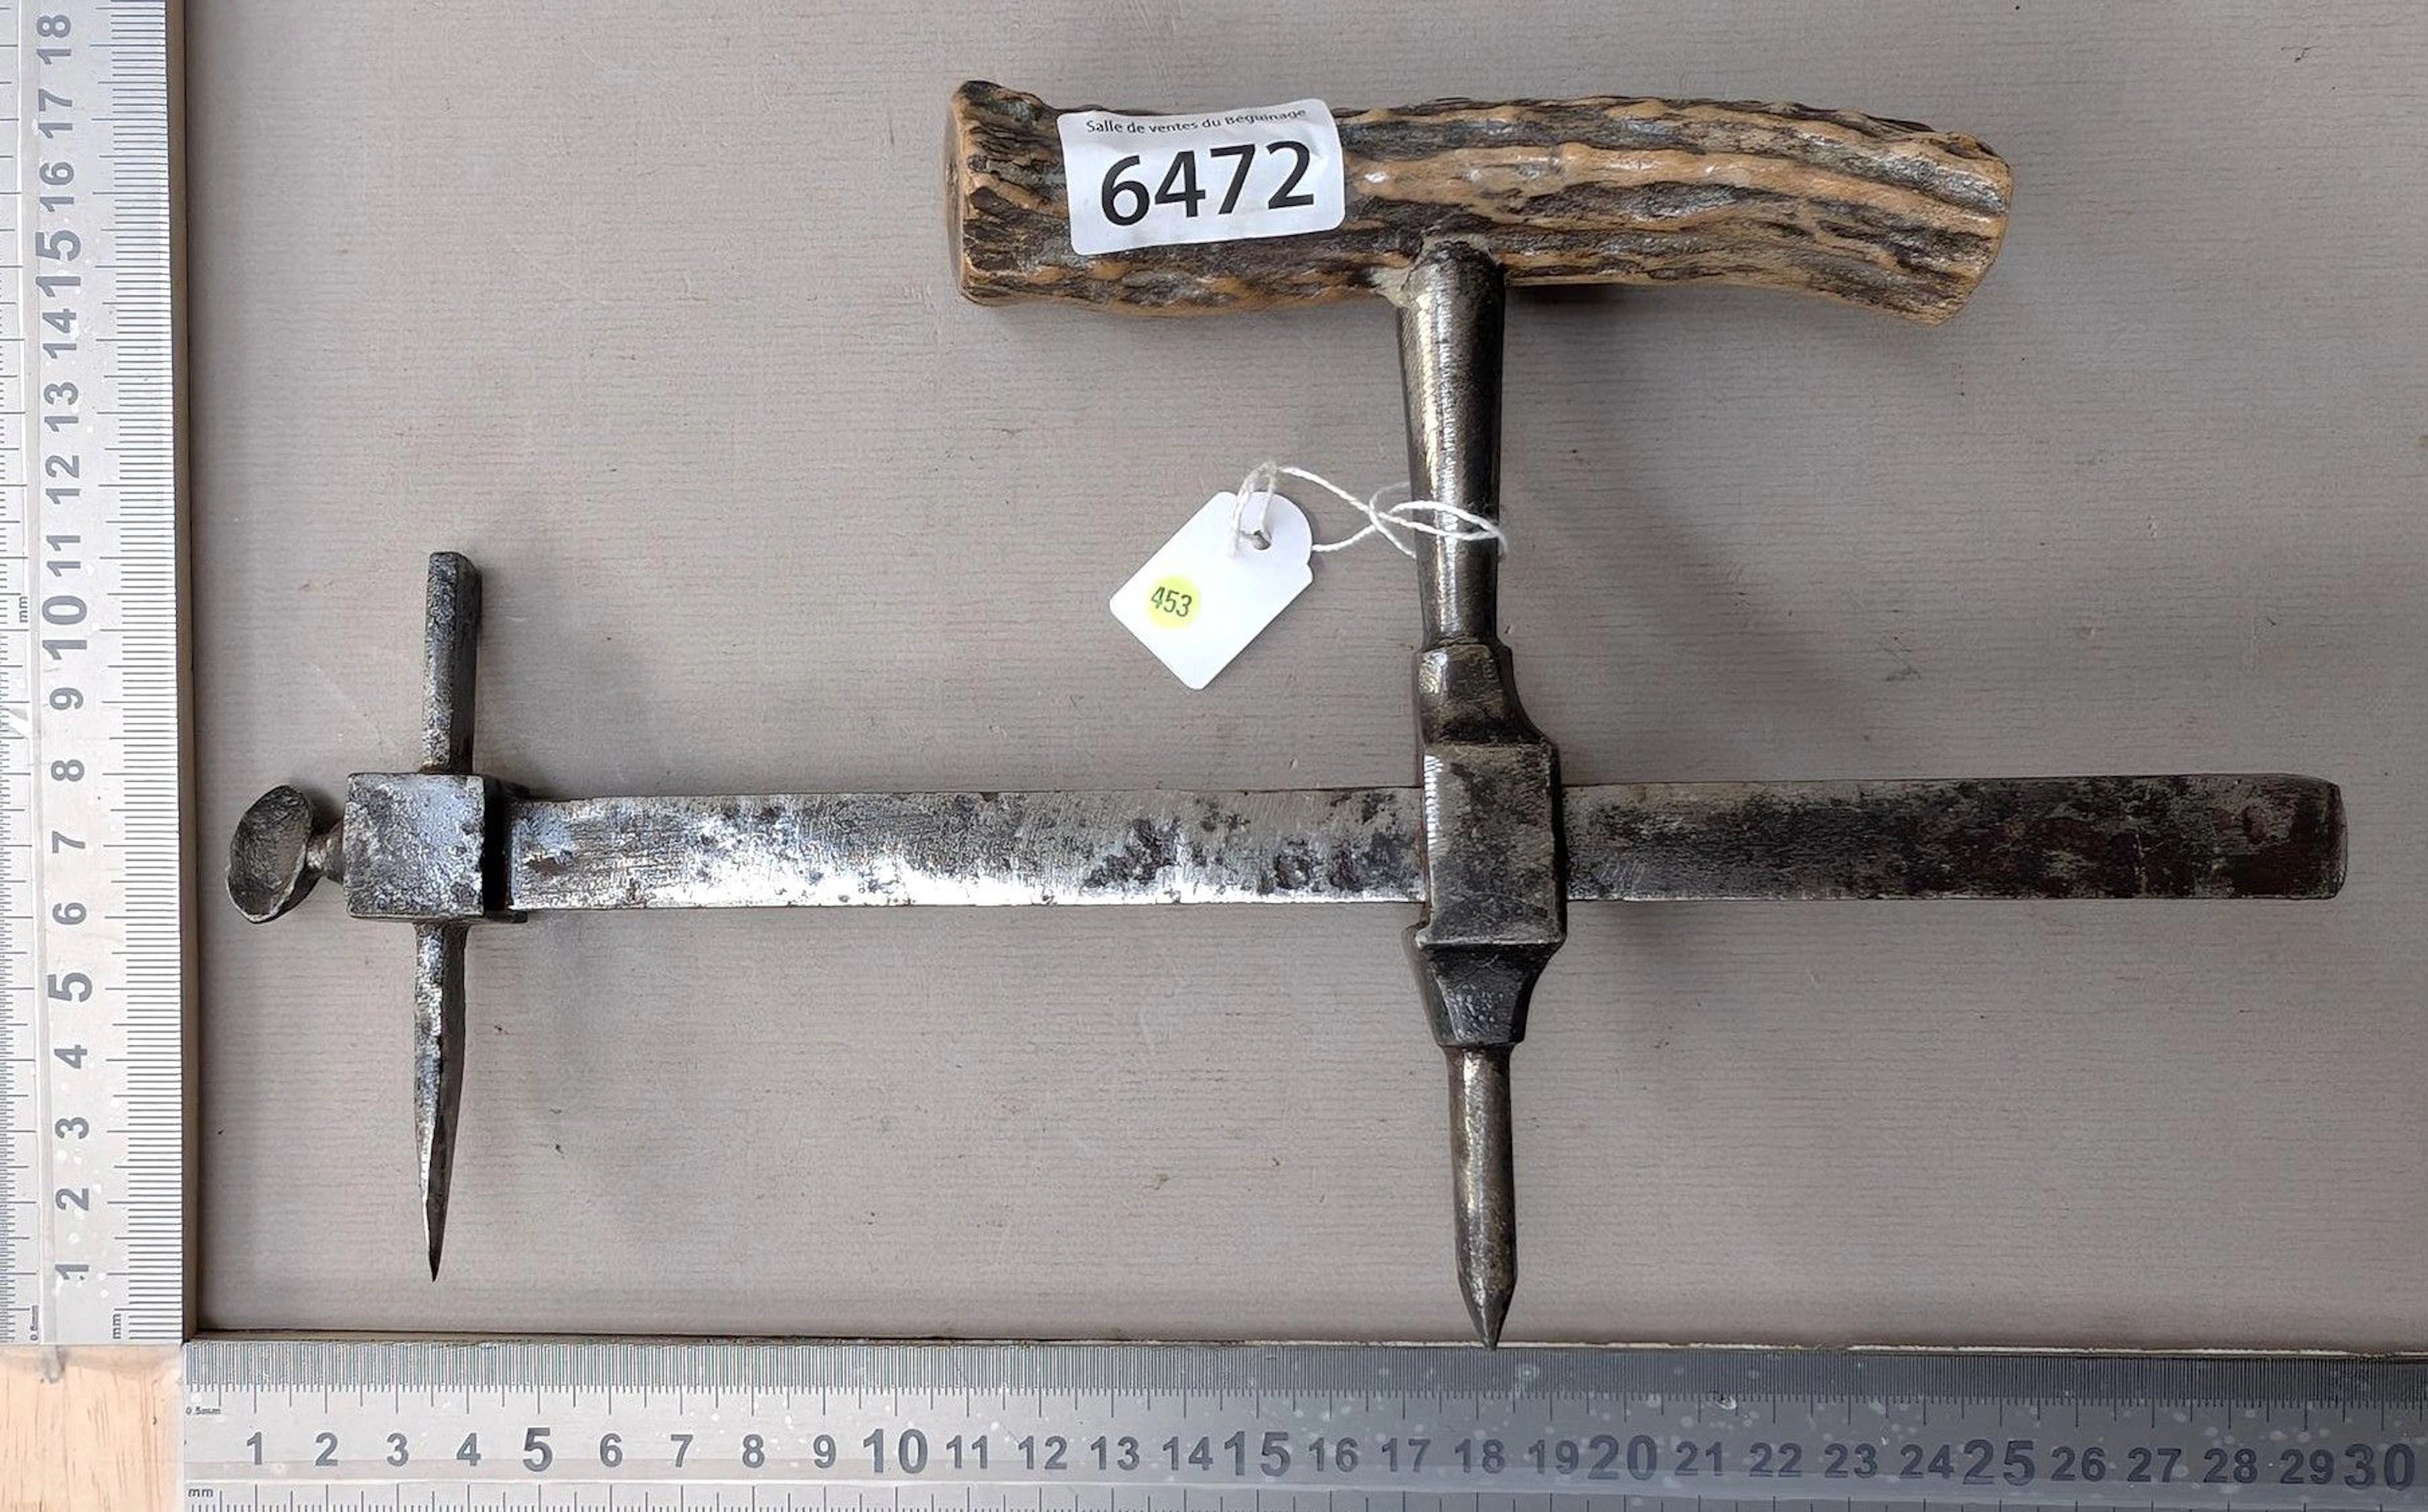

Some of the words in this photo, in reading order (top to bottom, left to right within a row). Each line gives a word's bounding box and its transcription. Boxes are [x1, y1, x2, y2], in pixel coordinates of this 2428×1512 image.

[36, 14, 71, 64] 18
[38, 88, 73, 139] 17
[1086, 119, 1123, 133] Salle
[1127, 121, 1145, 133] de
[1149, 122, 1198, 133] ventes
[1202, 118, 1222, 128] du
[39, 161, 75, 212] 16
[1101, 140, 1315, 226] 6472
[35, 229, 81, 297] 15
[42, 308, 77, 359] 14
[44, 382, 79, 432] 13
[45, 455, 81, 504] 12
[46, 535, 81, 577] 11
[18, 596, 28, 623] mm
[1151, 586, 1193, 617] 453
[42, 595, 87, 661] 10
[49, 687, 84, 710] 9
[51, 759, 85, 782] 8
[52, 831, 86, 853] 7
[52, 902, 87, 925] 6
[47, 972, 93, 1003] 5
[54, 1045, 87, 1069] 4
[54, 1117, 89, 1139] 3
[55, 1188, 89, 1211] 2
[55, 1264, 89, 1280] 1
[113, 1314, 121, 1339] mm
[247, 1432, 262, 1465] 1
[316, 1432, 339, 1466] 2
[386, 1433, 409, 1466] 3
[456, 1433, 481, 1466] 4
[522, 1427, 552, 1472] 5
[599, 1433, 623, 1468] 6
[671, 1434, 694, 1468] 7
[742, 1434, 765, 1468] 8
[813, 1434, 837, 1468] 9
[863, 1429, 928, 1473] 10
[946, 1435, 988, 1470] 11
[1019, 1436, 1068, 1470] 12
[1090, 1436, 1140, 1470] 13
[1163, 1436, 1213, 1471] 14
[1224, 1431, 1291, 1477] 15
[1308, 1437, 1359, 1472] 16
[1382, 1437, 1431, 1473] 17
[1454, 1438, 1505, 1474] 18
[1528, 1439, 1579, 1475] 19
[1588, 1434, 1658, 1480] 20
[1674, 1441, 1722, 1477] 21
[1749, 1442, 1803, 1478] 22
[1825, 1443, 1878, 1479] 23
[1899, 1444, 1954, 1480] 24
[1963, 1439, 2035, 1486] 25
[2051, 1446, 2107, 1482] 26
[2127, 1447, 2181, 1483] 27
[2204, 1448, 2258, 1484] 28
[2280, 1449, 2335, 1485] 29
[2344, 1442, 2415, 1491] 30
[188, 1487, 214, 1498] mm
